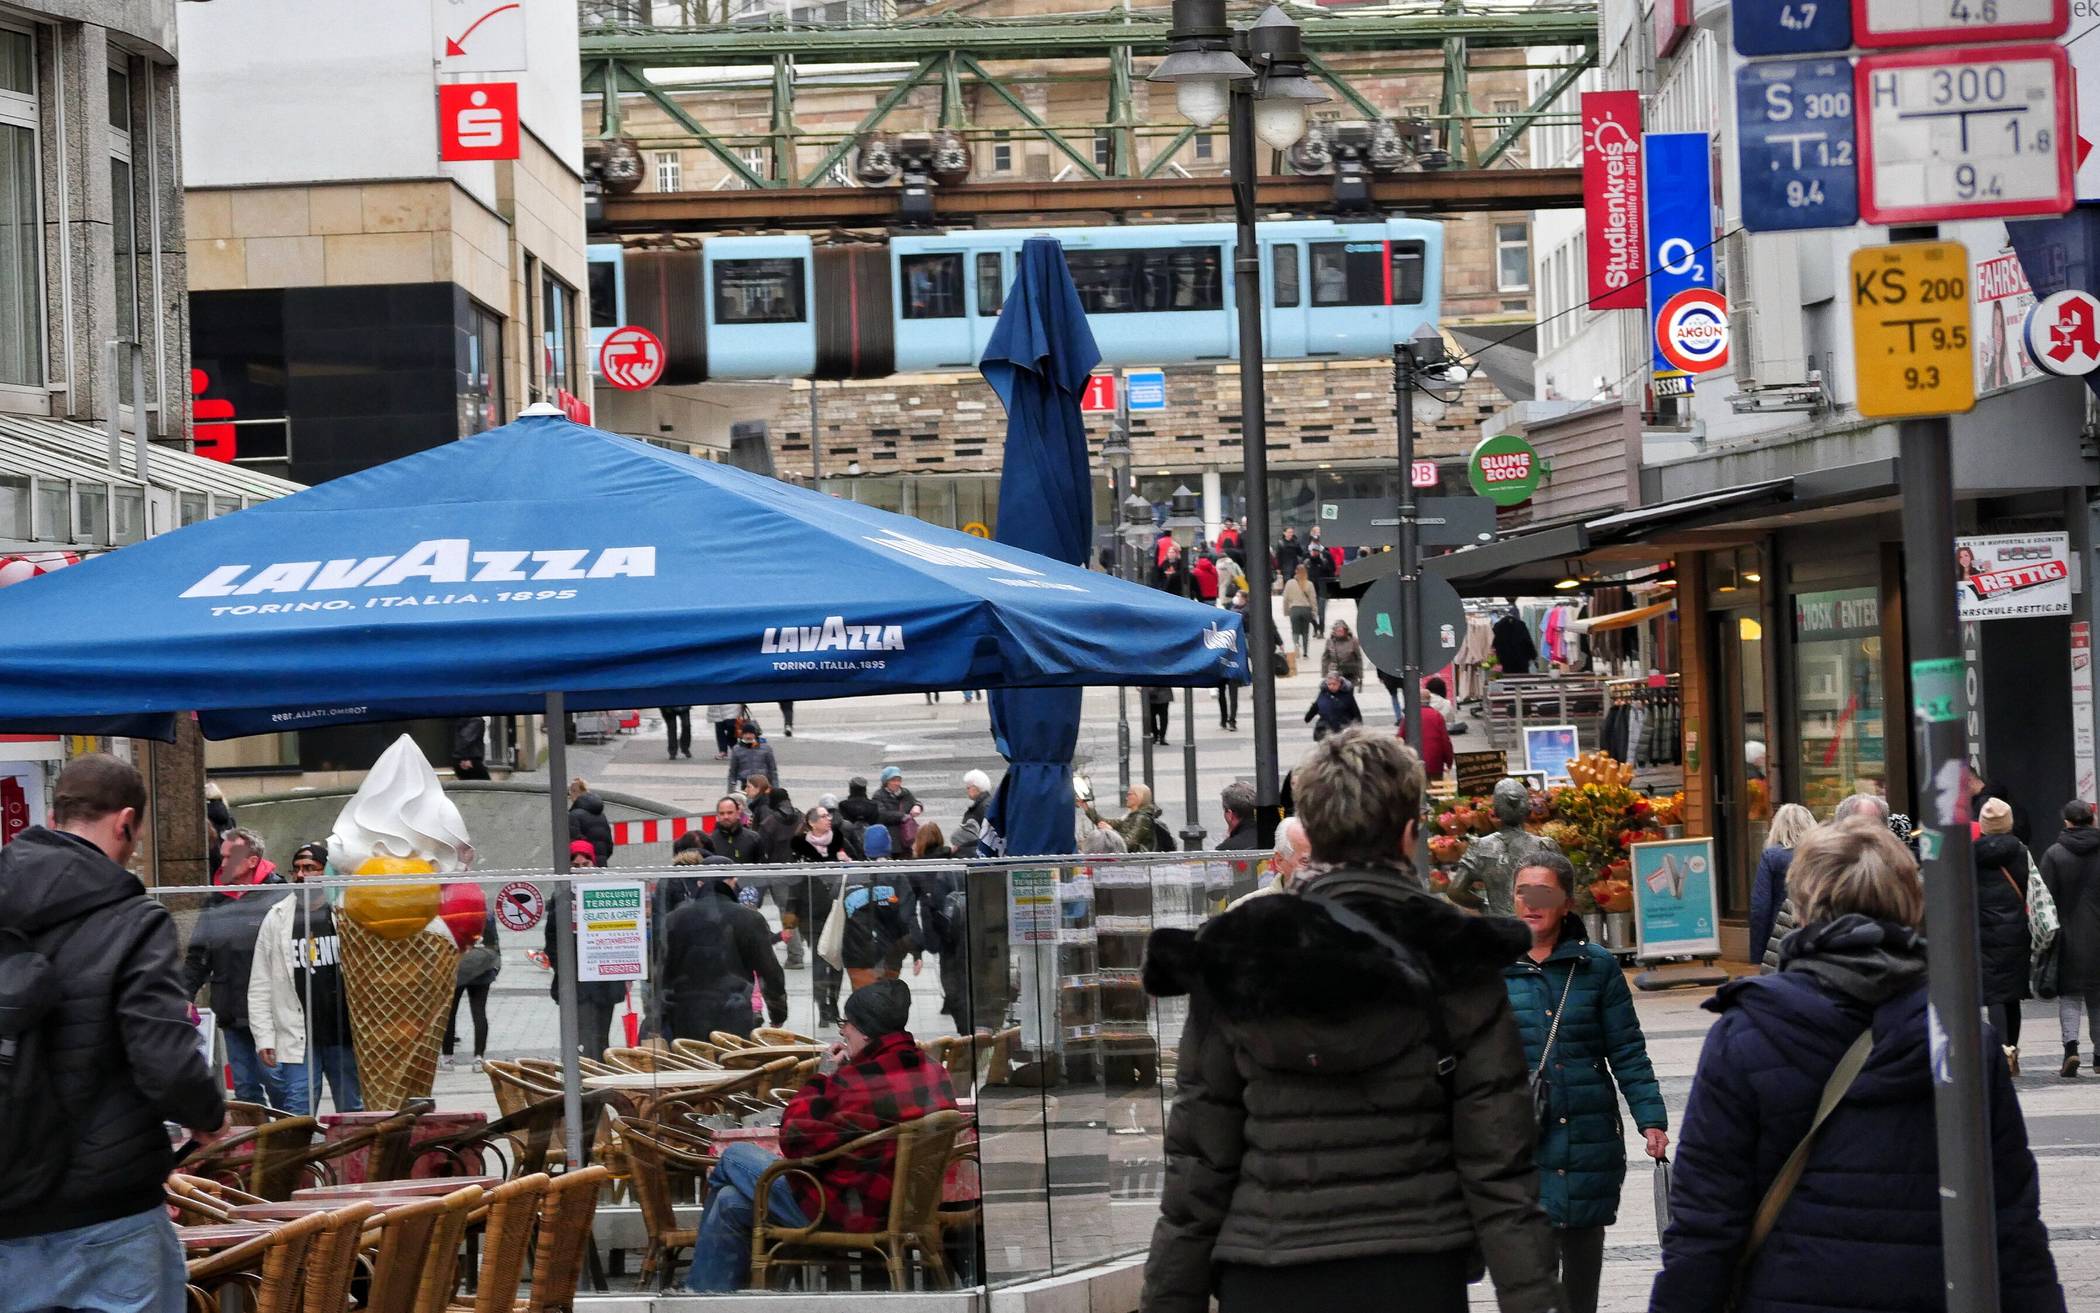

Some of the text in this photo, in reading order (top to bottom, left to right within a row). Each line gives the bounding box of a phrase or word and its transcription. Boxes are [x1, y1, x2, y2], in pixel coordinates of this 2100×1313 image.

[1780, 4, 1817, 29] 4.7
[1951, 0, 1997, 22] 4.6
[1874, 67, 2006, 107] H 300
[1765, 83, 1851, 121] S 300
[2006, 118, 2050, 155] 1.8
[1817, 140, 1853, 167] 1.2
[1787, 180, 1824, 207] 9.4
[1956, 163, 2001, 199] 9.4
[1601, 142, 1629, 288] Studienkreis
[1855, 268, 1964, 305] KS 200
[1931, 327, 1967, 351] 9.5
[1904, 366, 1940, 390] 9.3
[1480, 453, 1531, 469] BLUME
[1486, 467, 1528, 481] 2000
[177, 538, 655, 598] LAVAZZA
[1978, 562, 2062, 592] RETTIG
[497, 590, 577, 602] 1895
[1959, 603, 2069, 617] HRSCHULE-RETTIG.DE
[761, 616, 905, 654] LAVAZZA
[860, 661, 885, 669] 1895
[585, 899, 639, 907] TERRASSE
[595, 891, 639, 899] EXCLUSIVE
